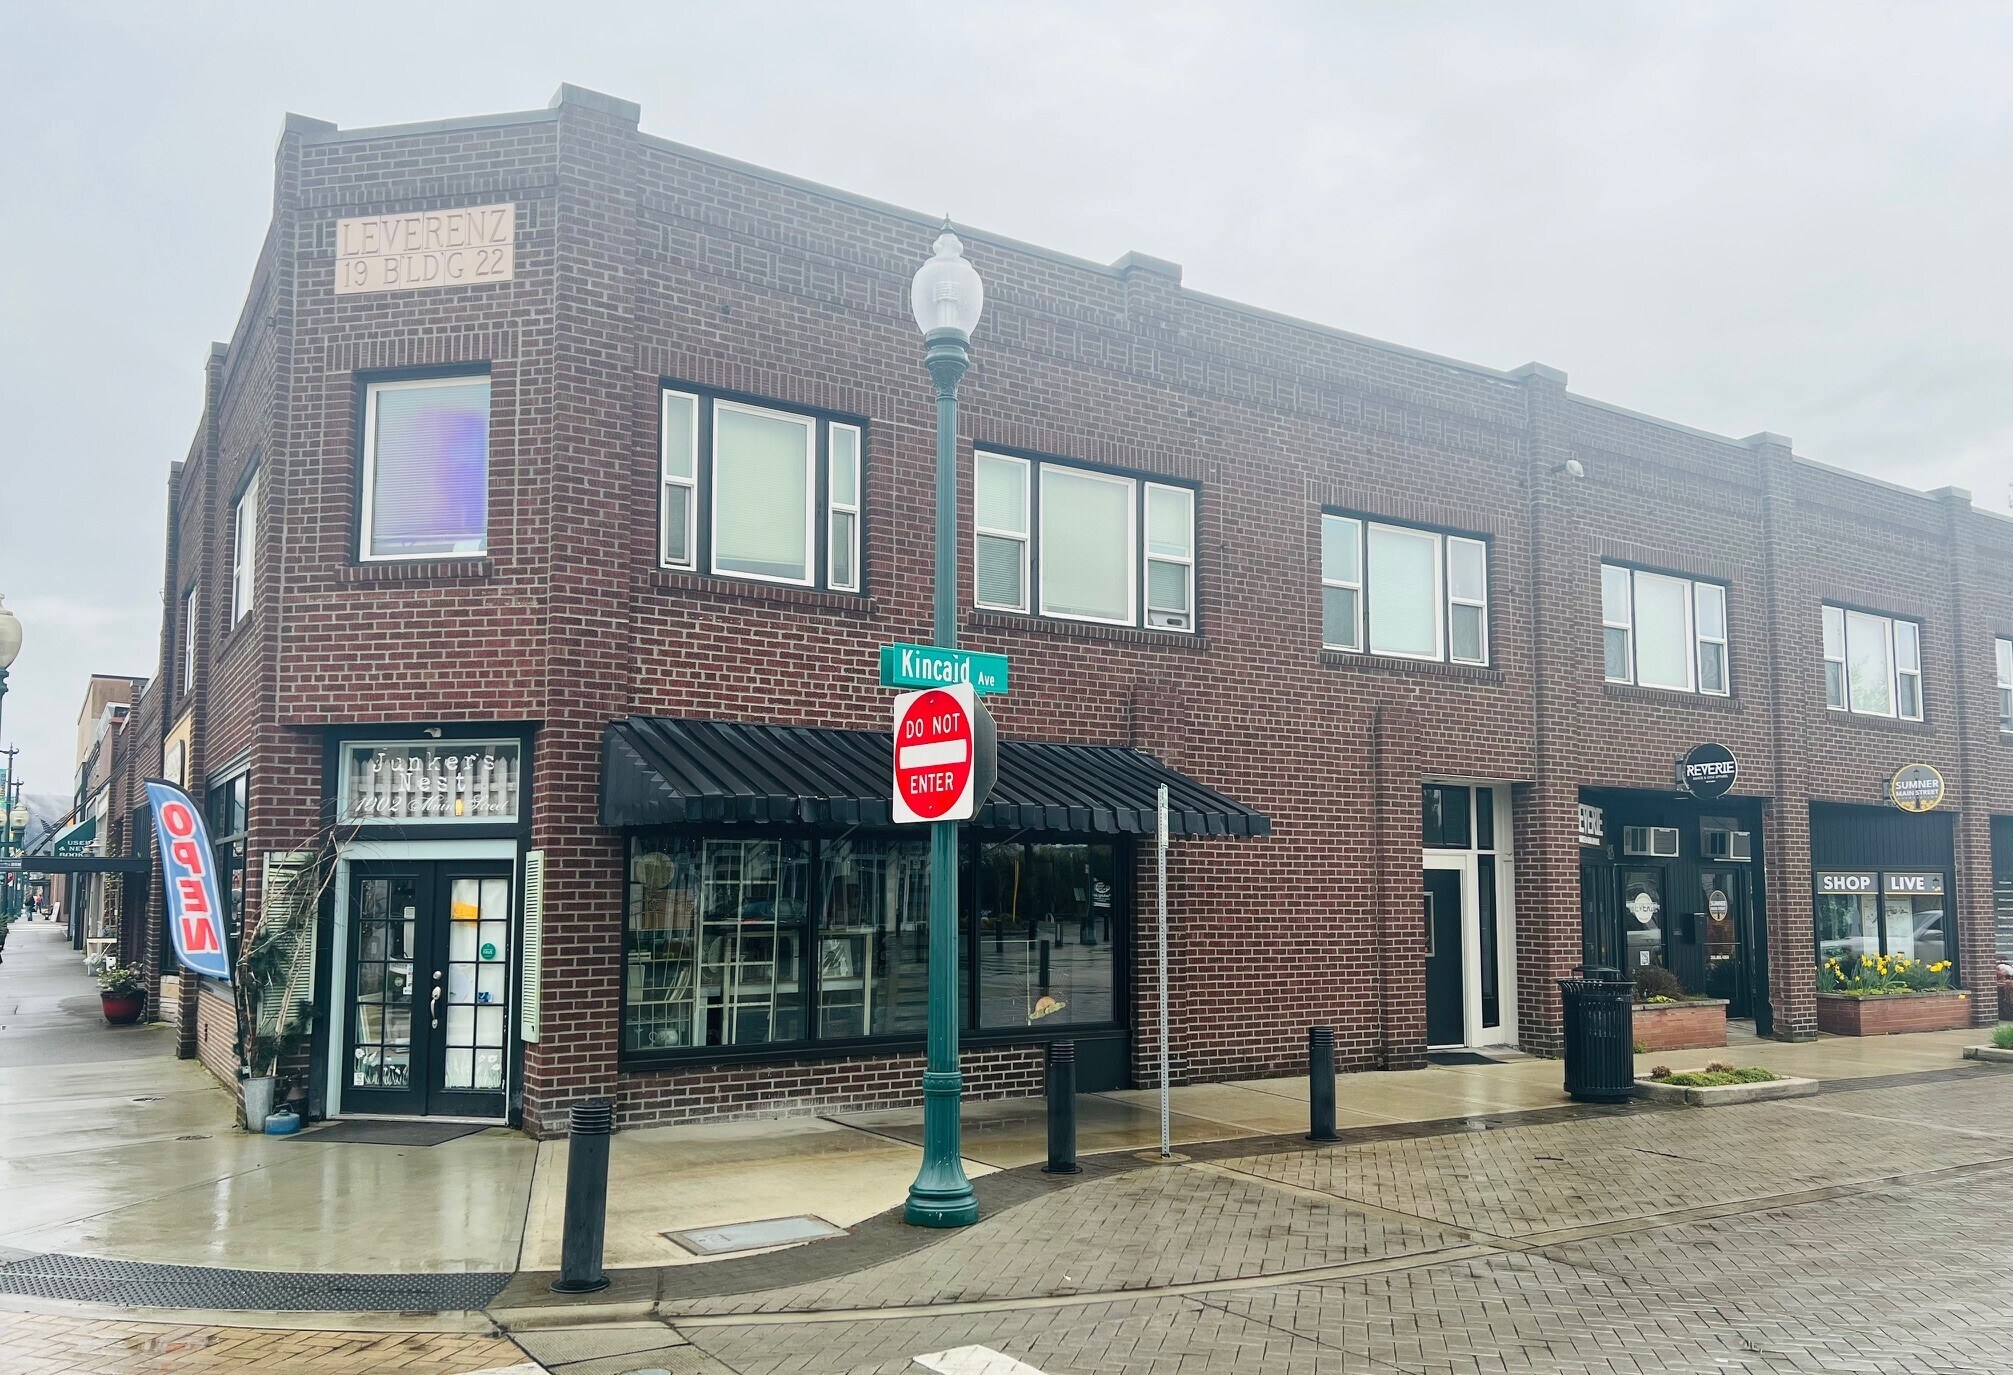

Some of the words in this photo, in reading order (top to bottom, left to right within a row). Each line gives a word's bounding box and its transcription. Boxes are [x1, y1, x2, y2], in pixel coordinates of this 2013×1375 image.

[343, 210, 507, 256] LEVERENZ
[344, 260, 368, 288] 19
[475, 248, 505, 276] 22
[902, 648, 970, 684] Kincaid
[978, 671, 995, 687] Ave
[906, 718, 924, 739] DO
[932, 713, 960, 735] NOT
[372, 748, 495, 773] Junker's
[1686, 761, 1735, 777] REVERIE
[398, 772, 466, 792] Nest
[910, 771, 954, 795] ENTER
[1895, 779, 1939, 790] SUMNER
[354, 796, 402, 812] 1902
[407, 795, 455, 812] Main
[464, 795, 510, 812] Street
[1579, 803, 1604, 836] EVERIE
[1823, 875, 1870, 890] SHOP
[1891, 876, 1925, 890] LIVE
